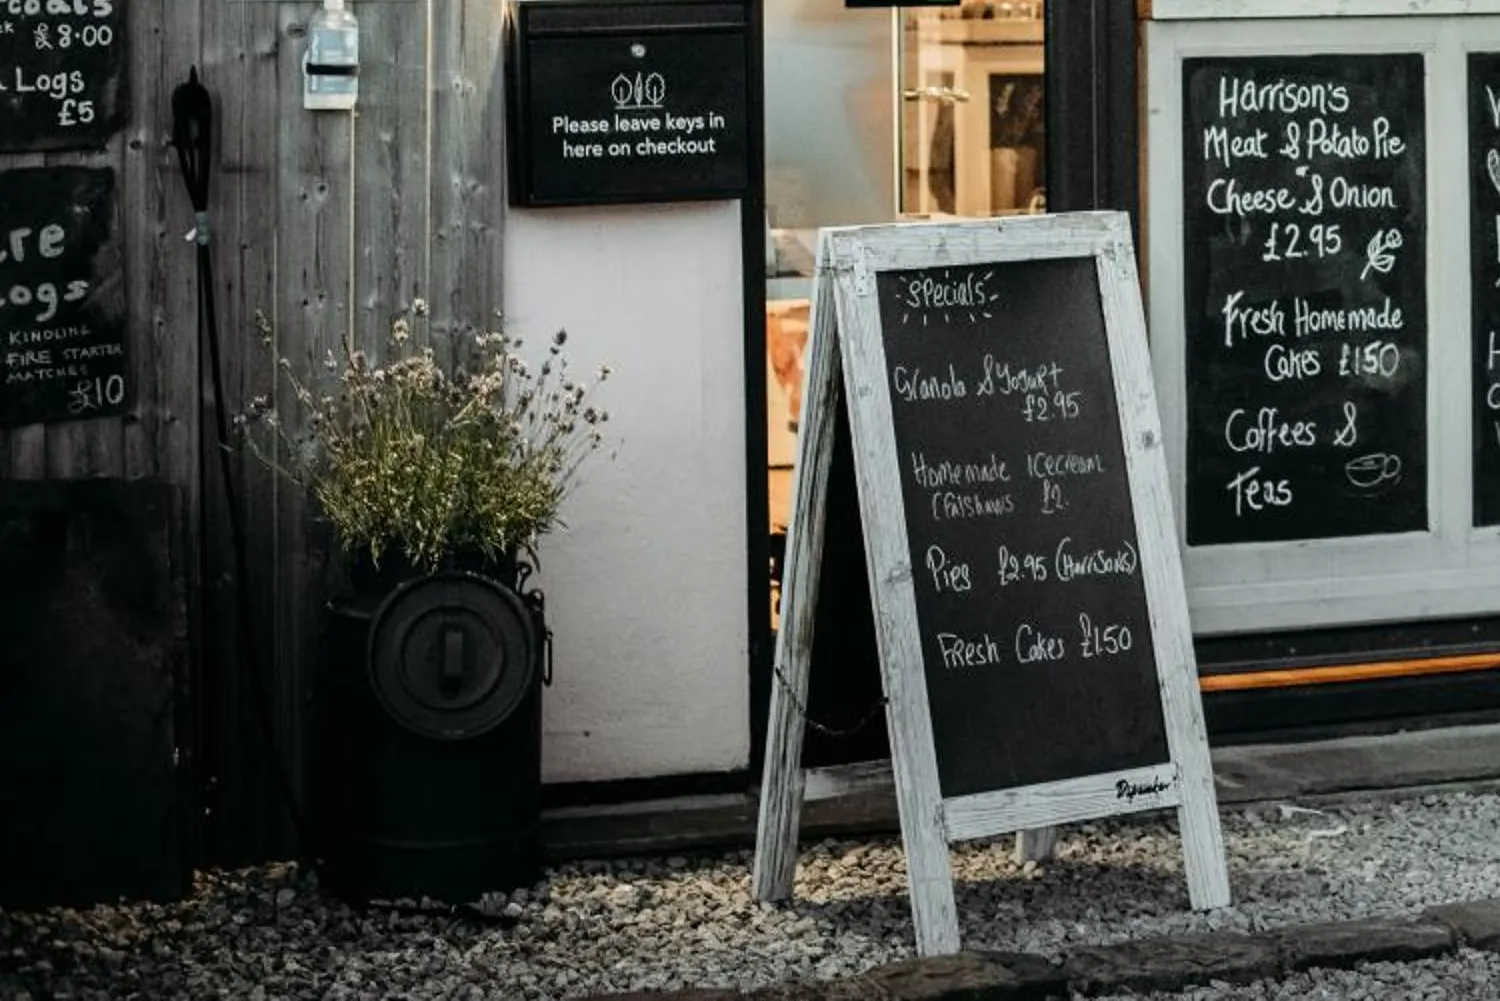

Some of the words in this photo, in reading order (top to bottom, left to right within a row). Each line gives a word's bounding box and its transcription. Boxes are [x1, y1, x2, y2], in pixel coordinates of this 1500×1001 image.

[15, 66, 85, 100] Logs
[58, 98, 95, 126] £5
[552, 115, 609, 134] Please
[614, 113, 661, 133] leave
[665, 112, 706, 135] keys
[709, 111, 726, 130] in
[562, 139, 604, 159] here
[607, 142, 631, 157] on
[635, 136, 717, 157] checkout
[1203, 125, 1268, 168] Meat
[1308, 118, 1369, 159] Potato
[1373, 116, 1406, 159] Pie
[1206, 178, 1296, 216] Cheese
[1299, 174, 1323, 216] &
[1329, 176, 1398, 209] Onion
[1262, 222, 1342, 263] £2.95
[0, 280, 90, 322] ogs
[1222, 290, 1286, 348] Fresh
[1294, 296, 1404, 337] Homemade
[5, 349, 53, 367] FIRE
[1265, 343, 1321, 381] Cakes
[66, 374, 125, 414] £10
[893, 364, 968, 402] Granola
[1022, 390, 1083, 423] £2.95
[1225, 407, 1317, 453] Coffees
[1332, 400, 1357, 447] &
[1227, 465, 1293, 517] Teas
[926, 544, 972, 592] Pies
[997, 544, 1048, 587] £2.95
[1015, 623, 1065, 664] Cakes
